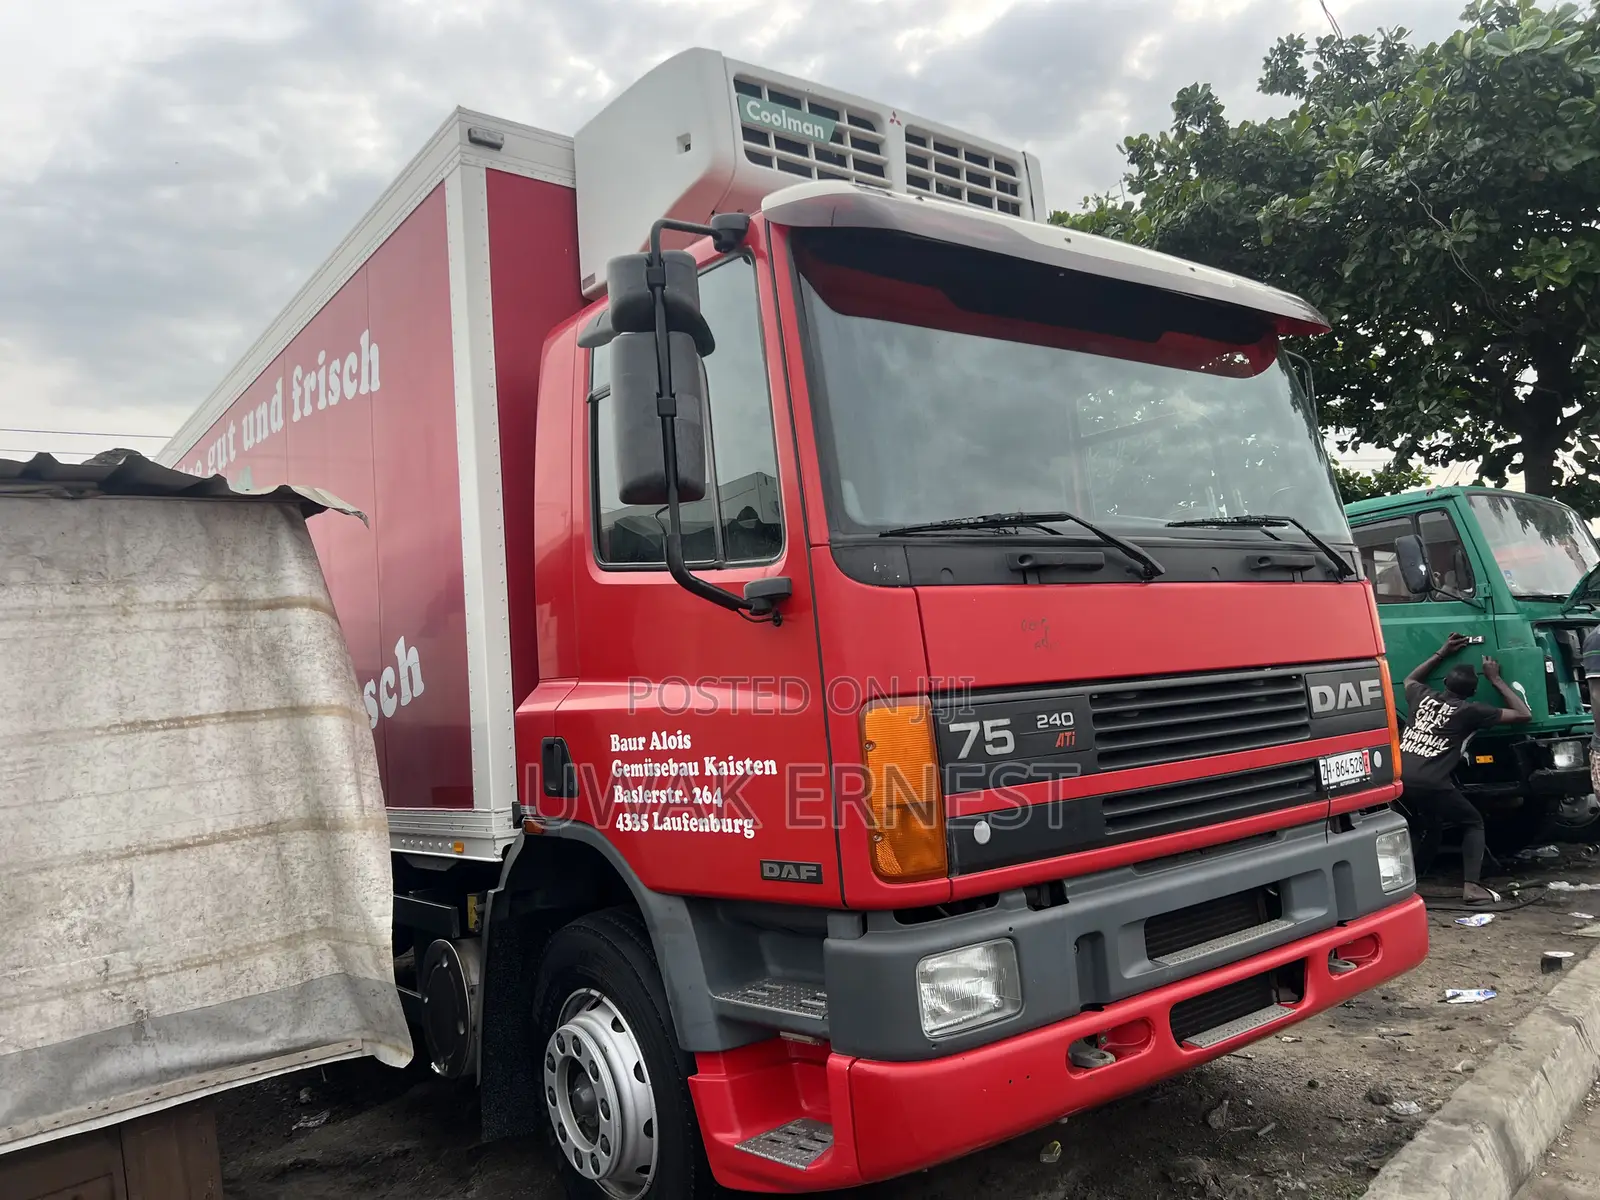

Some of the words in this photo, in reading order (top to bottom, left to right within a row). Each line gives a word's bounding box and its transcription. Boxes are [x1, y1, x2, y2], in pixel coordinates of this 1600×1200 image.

[746, 100, 824, 140] Coolman
[207, 419, 237, 477] gut
[242, 378, 284, 452] und
[292, 329, 381, 422] frisch
[364, 636, 424, 729] sch
[1310, 679, 1382, 713] DAF
[1438, 702, 1458, 715] ME
[1415, 708, 1450, 728] CARRY
[610, 734, 646, 752] Baur
[649, 729, 692, 750] Alois
[948, 718, 1015, 760] 75
[1036, 711, 1074, 729] 240
[611, 758, 700, 777] Gemüsebau
[704, 755, 778, 776] Kaisten
[613, 784, 688, 804] Baslerstr.
[692, 785, 723, 808] 264
[615, 812, 650, 832] 4335
[652, 811, 755, 839] Laufenburg
[762, 862, 817, 880] DAF
